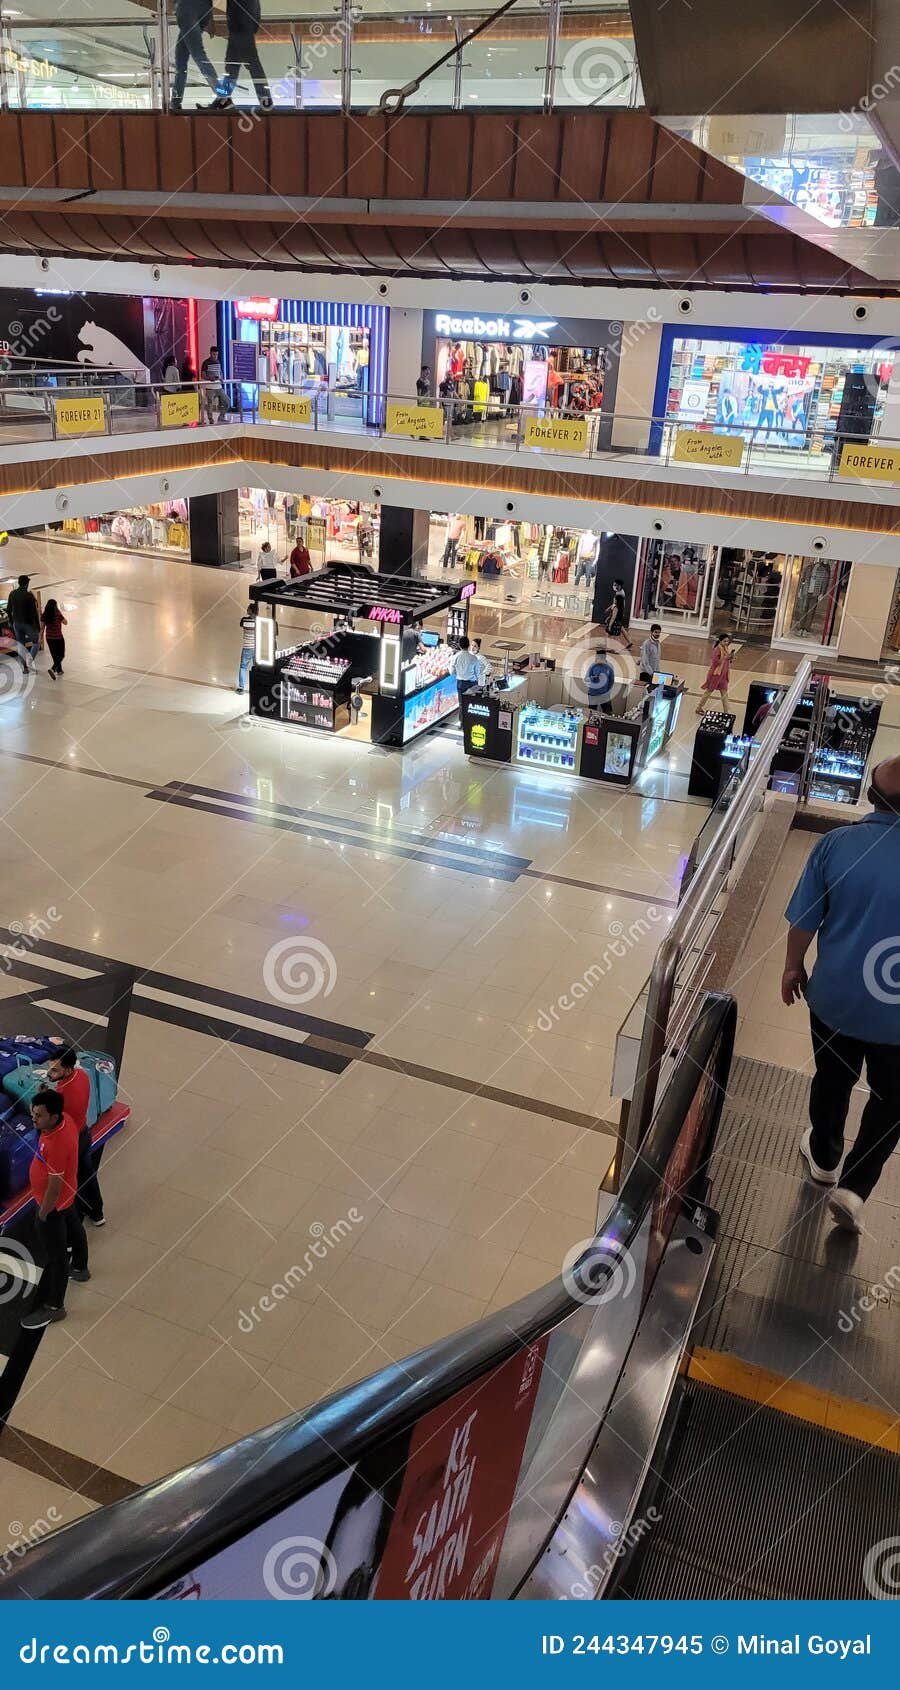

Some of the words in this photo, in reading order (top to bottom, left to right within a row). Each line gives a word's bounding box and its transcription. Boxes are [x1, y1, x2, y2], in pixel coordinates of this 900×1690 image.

[435, 314, 510, 337] Reebok
[262, 400, 297, 414] FOREVER
[299, 404, 307, 415] 21
[60, 410, 91, 423] FOREVER
[94, 409, 101, 420] 21
[530, 426, 569, 441] FOREVER
[573, 430, 582, 441] 21
[686, 438, 703, 446] From
[686, 446, 698, 454] Los
[700, 444, 723, 455] Angeles
[846, 454, 894, 471] FOREVER
[404, 1455, 477, 1583] SAATH
